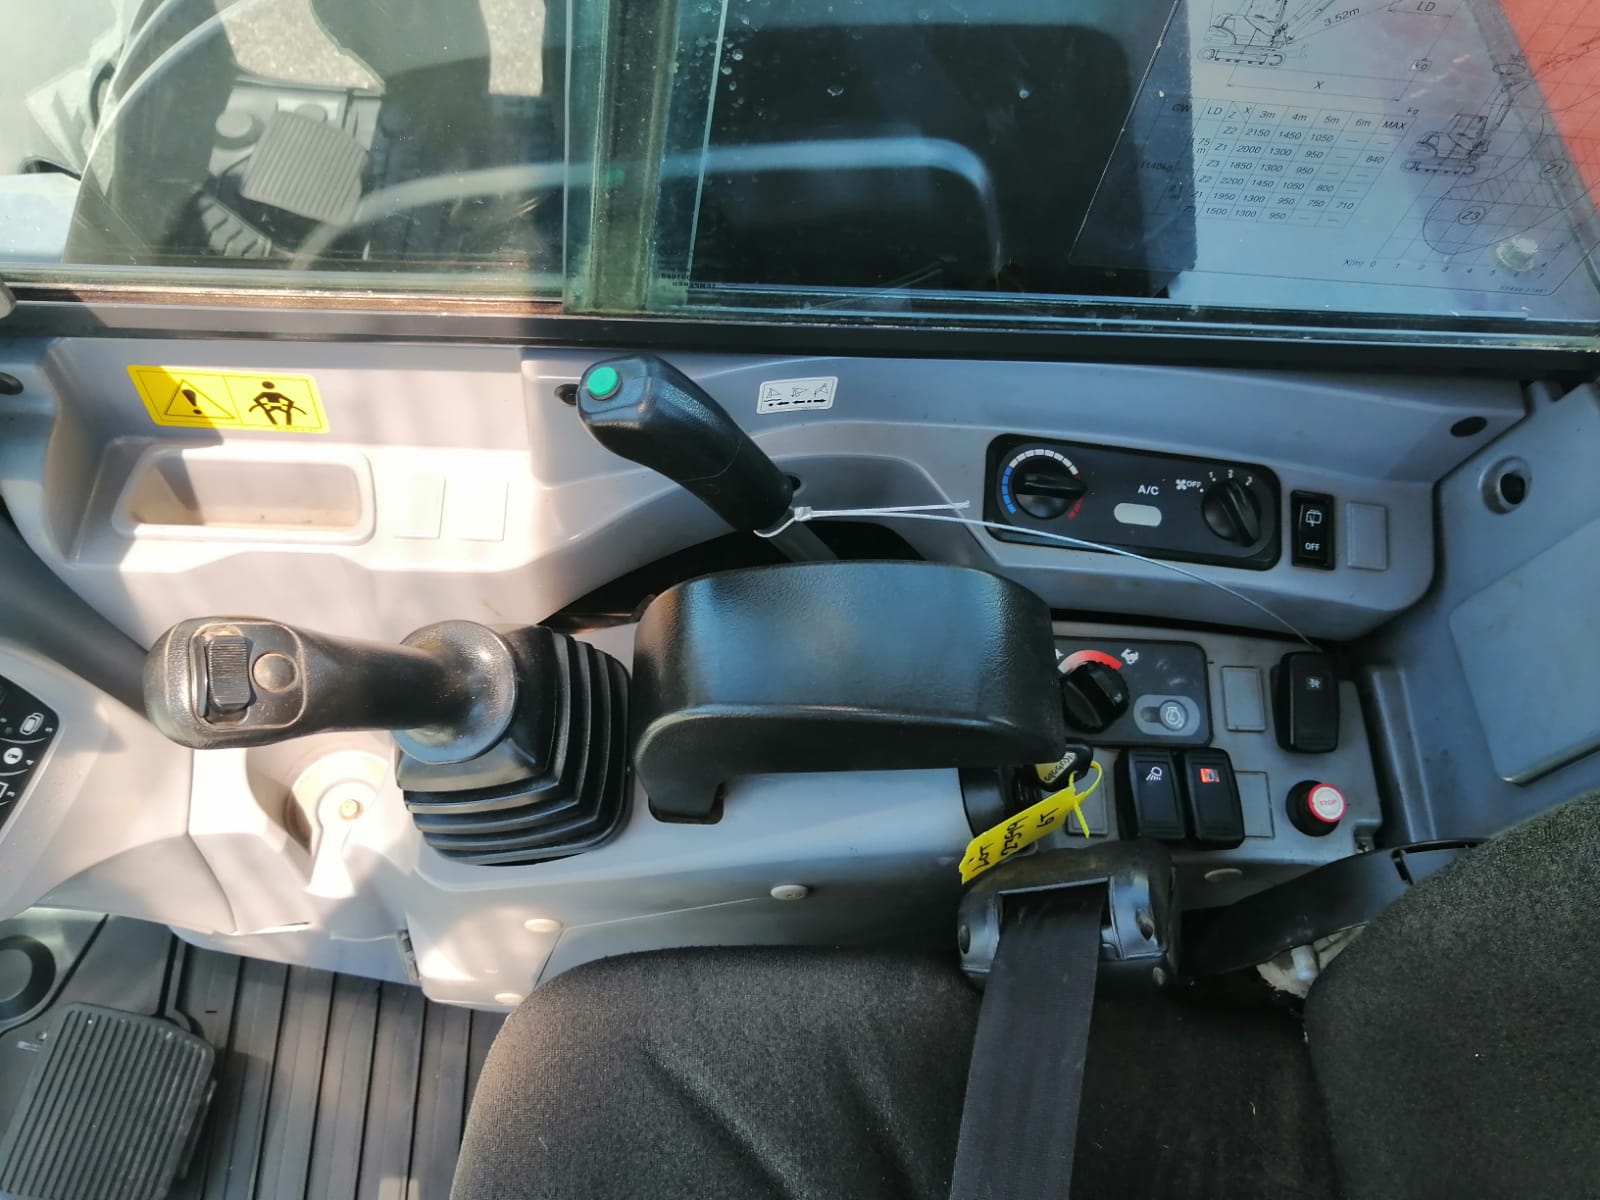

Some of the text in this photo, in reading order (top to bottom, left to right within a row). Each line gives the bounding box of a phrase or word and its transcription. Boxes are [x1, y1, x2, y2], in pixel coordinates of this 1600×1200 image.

[1416, 1, 1436, 12] LD
[1324, 8, 1360, 27] 3.52m
[1314, 80, 1324, 89] X
[1207, 106, 1222, 115] LD
[1259, 110, 1276, 119] 3m
[1292, 113, 1307, 121] 4m
[1323, 115, 1339, 125] 5m
[1355, 118, 1371, 127] 6m
[1382, 120, 1407, 130] MAX
[1223, 126, 1238, 135] Z2
[1245, 128, 1271, 137] 2150
[1279, 131, 1302, 140] 1450
[1311, 133, 1334, 142] 1050
[1214, 143, 1227, 151] Z1
[1236, 145, 1261, 154] 2000
[1270, 147, 1293, 156] 1300
[1304, 150, 1324, 158] 950
[1366, 155, 1384, 163] 840
[1206, 160, 1220, 168] Z3
[1229, 161, 1253, 170] 1850
[1260, 163, 1283, 172] 1300
[1296, 166, 1314, 175] 950
[1220, 177, 1244, 186] 2200
[1252, 179, 1274, 188] 1450
[1282, 181, 1305, 190] 1050
[1316, 184, 1334, 192] 800
[1213, 192, 1235, 201] 1950
[1243, 194, 1265, 203] 1300
[1277, 197, 1295, 206] 950
[1306, 199, 1325, 207] 750
[1337, 201, 1354, 210] 710
[1206, 207, 1228, 216] 1500
[1235, 209, 1257, 218] 1300
[1270, 212, 1287, 220] 950
[1461, 209, 1481, 221] Z3
[1186, 479, 1202, 489] OFF
[1137, 484, 1160, 496] A/C
[1305, 541, 1321, 552] OFF
[1319, 799, 1338, 807] STOP
